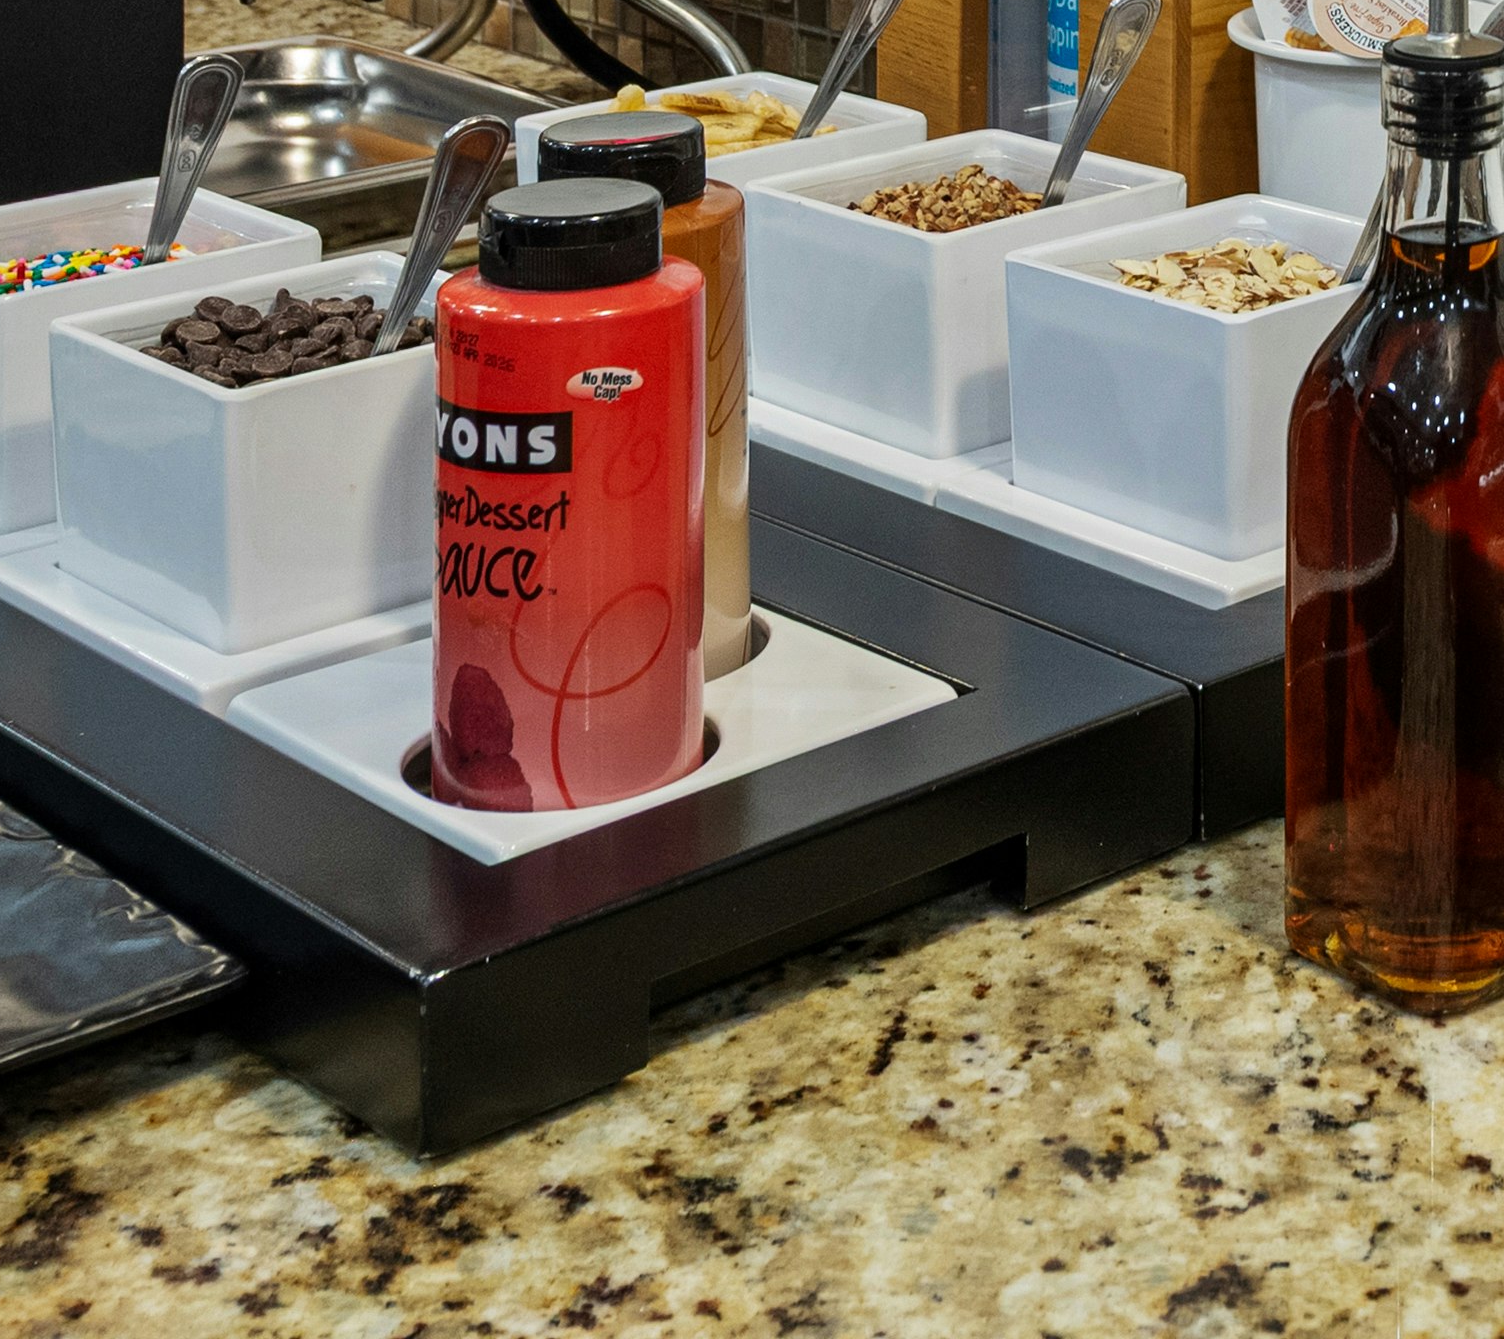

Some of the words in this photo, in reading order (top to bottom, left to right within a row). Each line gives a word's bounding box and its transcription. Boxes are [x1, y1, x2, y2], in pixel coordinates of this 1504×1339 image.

[582, 371, 598, 385] No
[601, 371, 632, 386] Mess
[594, 384, 621, 401] Cap!
[465, 485, 570, 531] Dessert
[436, 541, 543, 601] auce
